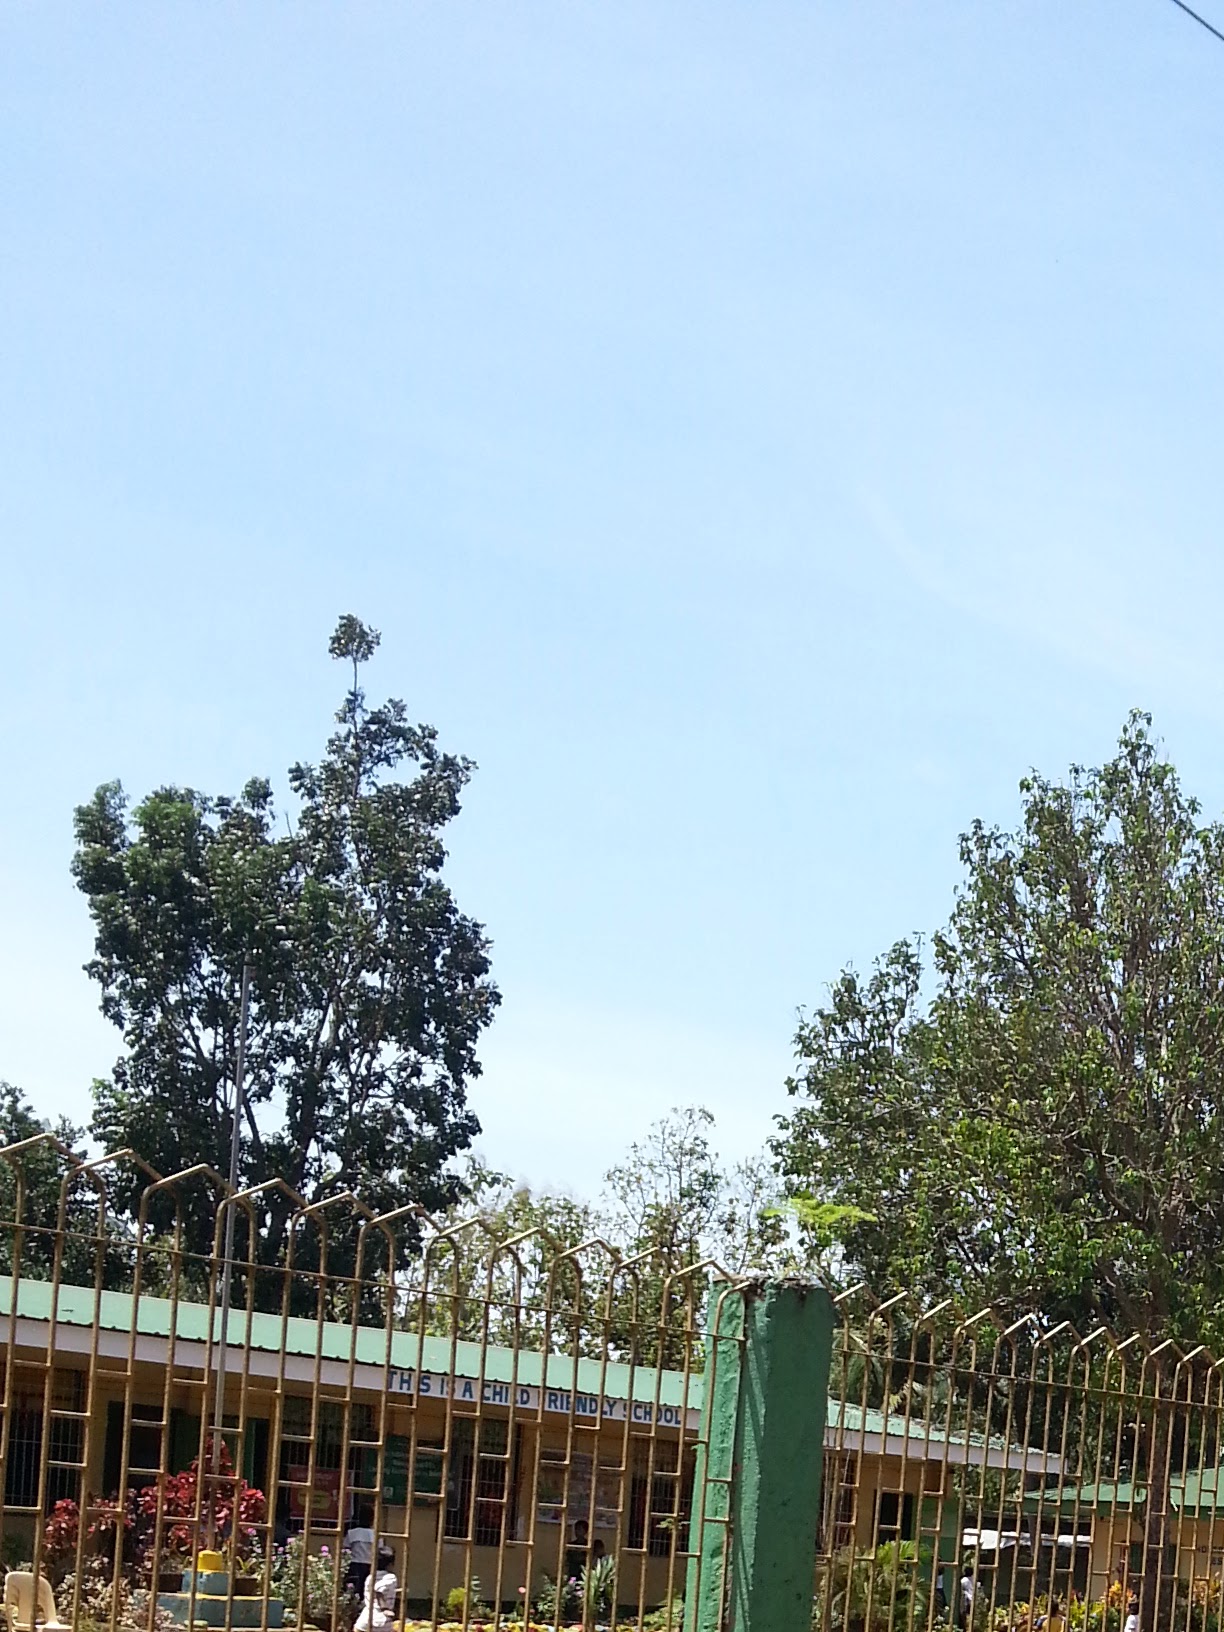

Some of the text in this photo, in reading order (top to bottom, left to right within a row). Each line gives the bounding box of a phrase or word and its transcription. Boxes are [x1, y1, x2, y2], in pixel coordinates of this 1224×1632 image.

[388, 1370, 431, 1393] THS
[462, 1380, 474, 1399] A
[483, 1383, 530, 1405] CHID
